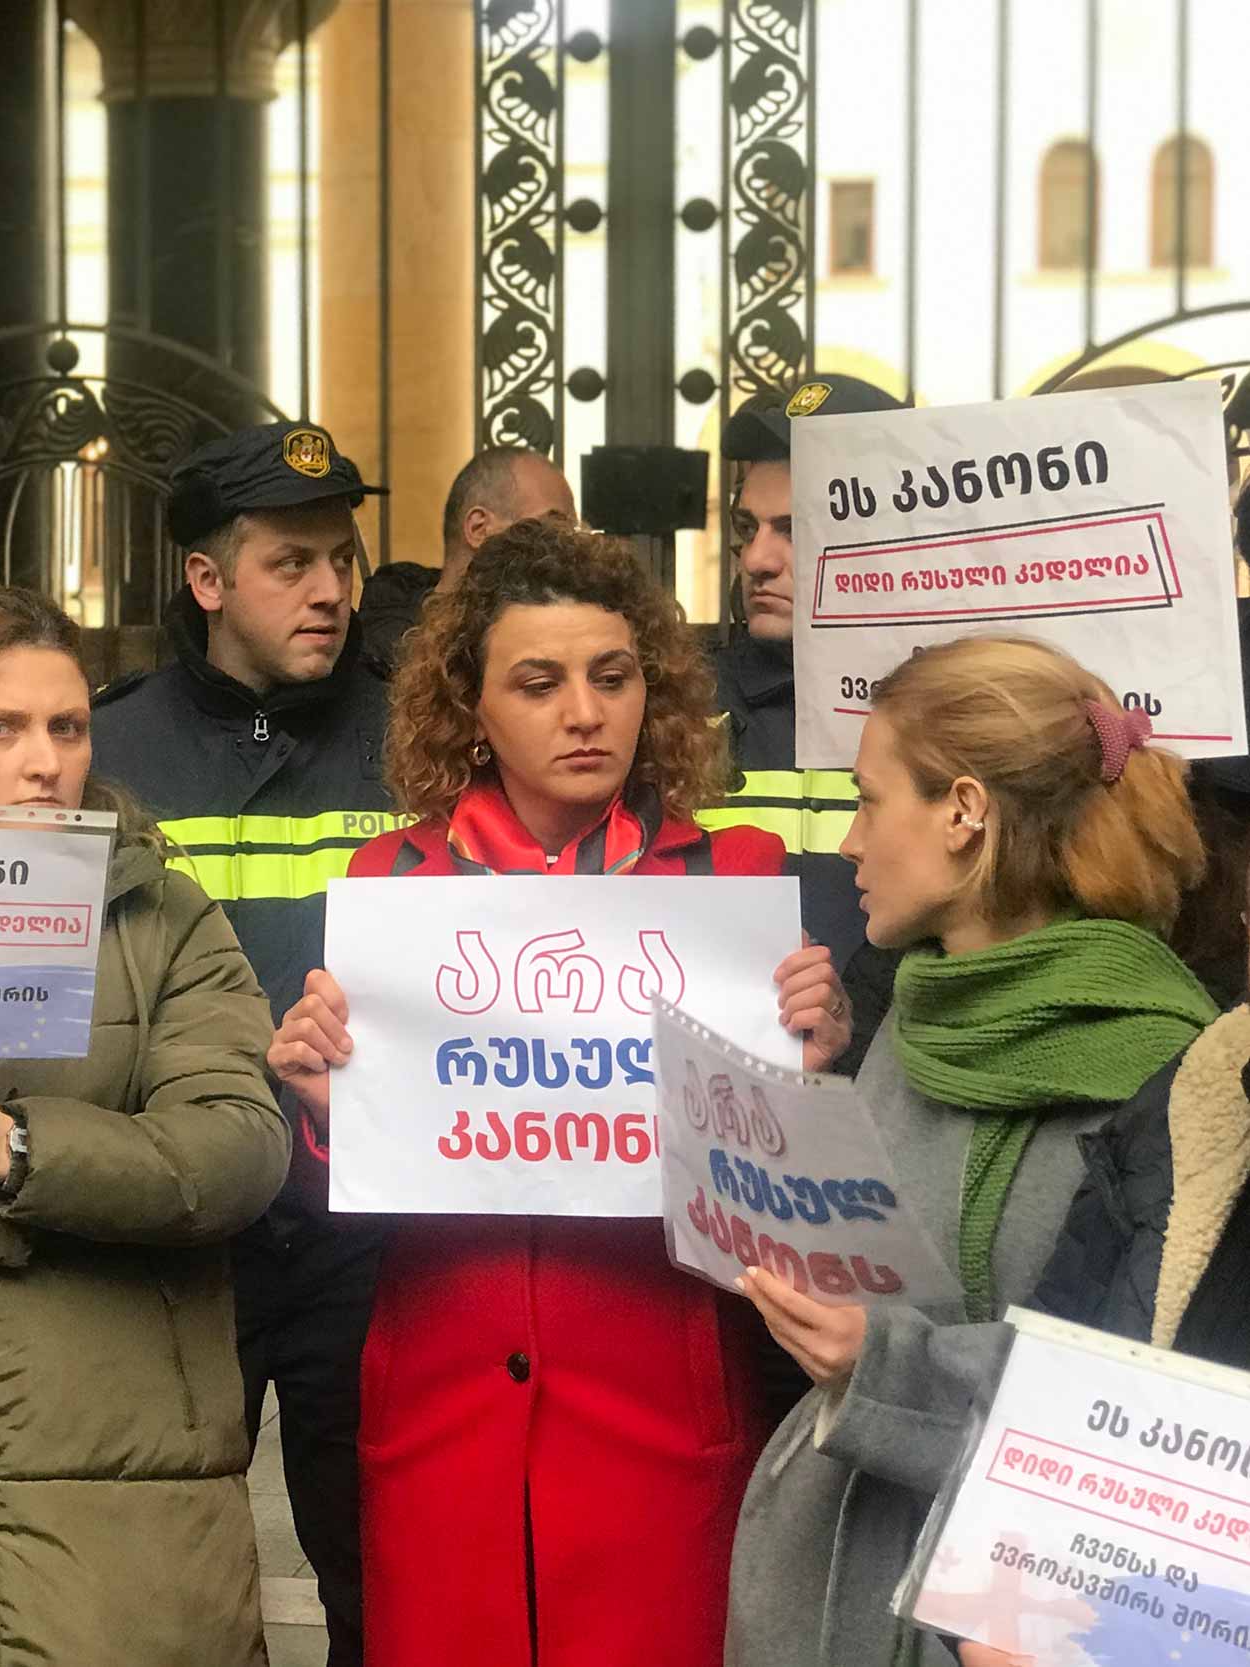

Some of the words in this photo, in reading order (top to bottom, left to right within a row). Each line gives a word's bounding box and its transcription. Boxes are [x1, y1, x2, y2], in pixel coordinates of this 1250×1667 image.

[829, 477, 876, 520] ეს
[893, 440, 1109, 513] კანონი
[835, 571, 894, 593] დიდი
[902, 563, 1007, 591] რუსული
[1015, 553, 1150, 585] კედელია
[436, 928, 685, 1015] არა
[437, 1111, 660, 1164] კანონ
[683, 1058, 786, 1157] არა
[709, 1148, 897, 1225] რუსულ
[687, 1185, 902, 1295] კანონს
[1087, 1400, 1129, 1438] ეს
[1003, 1446, 1073, 1485] დიდი
[1078, 1472, 1189, 1523] რუსული
[1194, 1509, 1250, 1543] კედ
[990, 1541, 1164, 1620] ევროკავშირს
[1172, 1603, 1250, 1650] შორი
[1070, 1533, 1156, 1579] ჩვენსა
[1166, 1563, 1199, 1593] და
